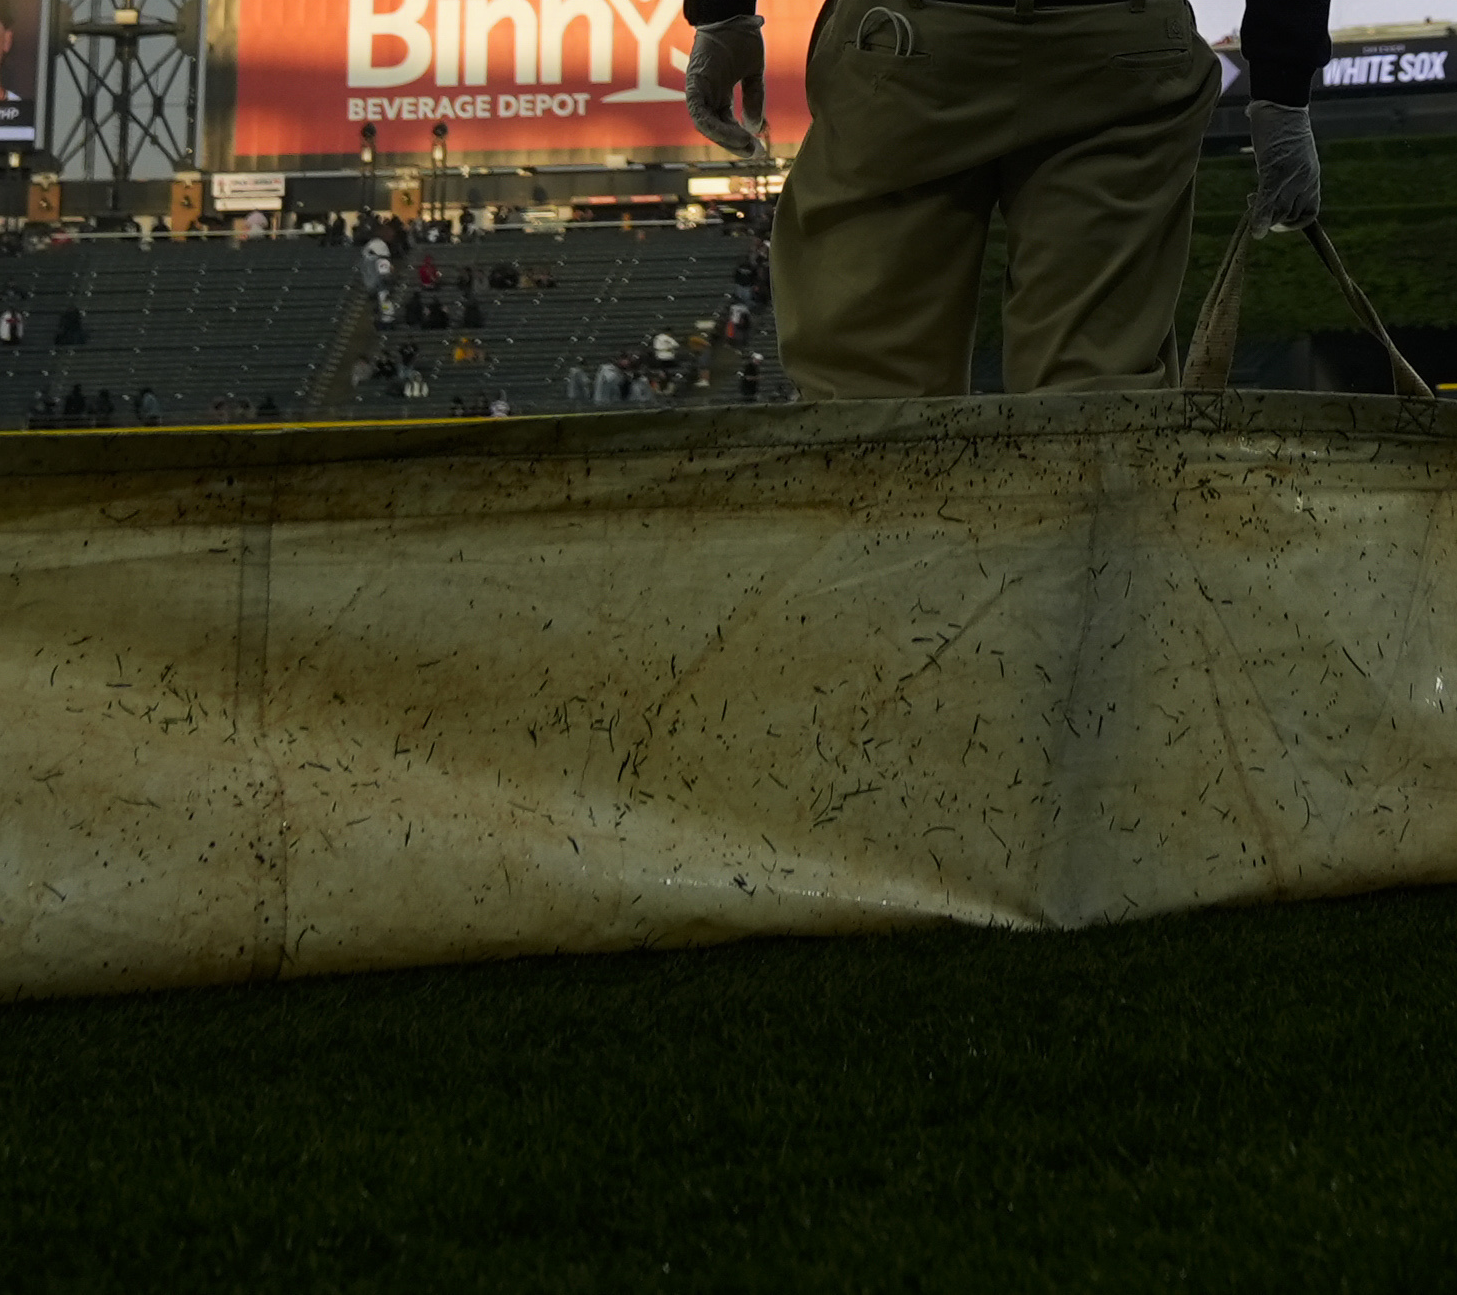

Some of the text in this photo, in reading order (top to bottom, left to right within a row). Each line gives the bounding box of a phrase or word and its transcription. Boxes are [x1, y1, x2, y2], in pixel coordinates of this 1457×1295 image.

[1323, 50, 1448, 87] WHITE SOX
[347, 92, 591, 121] BEVERAGE DEPOT
